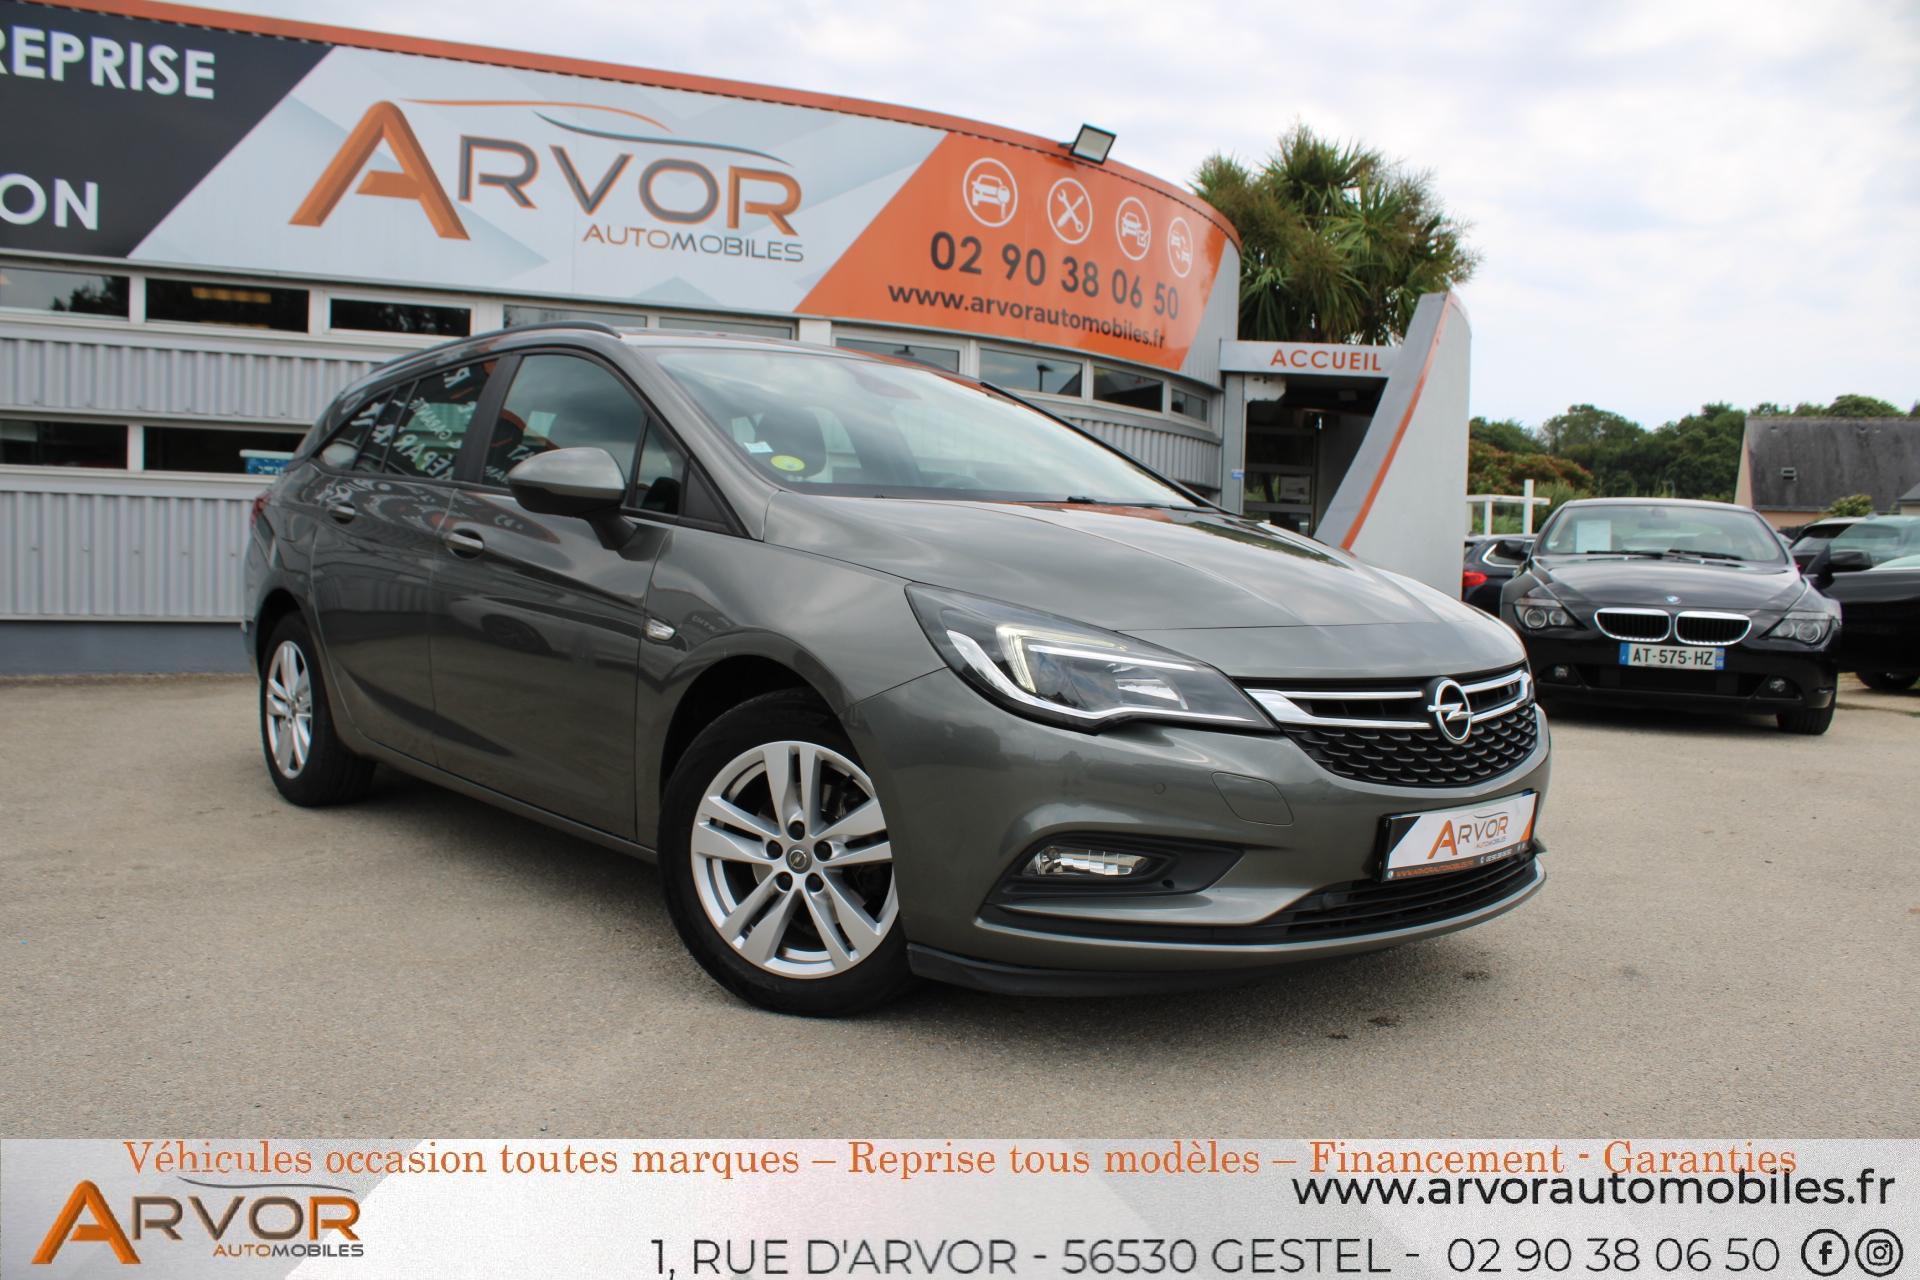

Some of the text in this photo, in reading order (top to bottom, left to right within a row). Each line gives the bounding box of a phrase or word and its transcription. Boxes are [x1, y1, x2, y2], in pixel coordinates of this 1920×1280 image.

[0, 25, 215, 100] EPRISE
[288, 100, 802, 241] ARVOR
[583, 224, 804, 262] AUTOMOBILES
[930, 231, 1179, 320] 02 90 38 06 50
[888, 284, 1165, 349] www.arvorautomobiles.fr
[1270, 349, 1382, 371] ACCUEIL
[1633, 647, 1713, 666] AT-575-HZ
[1427, 815, 1509, 860] ARVOR
